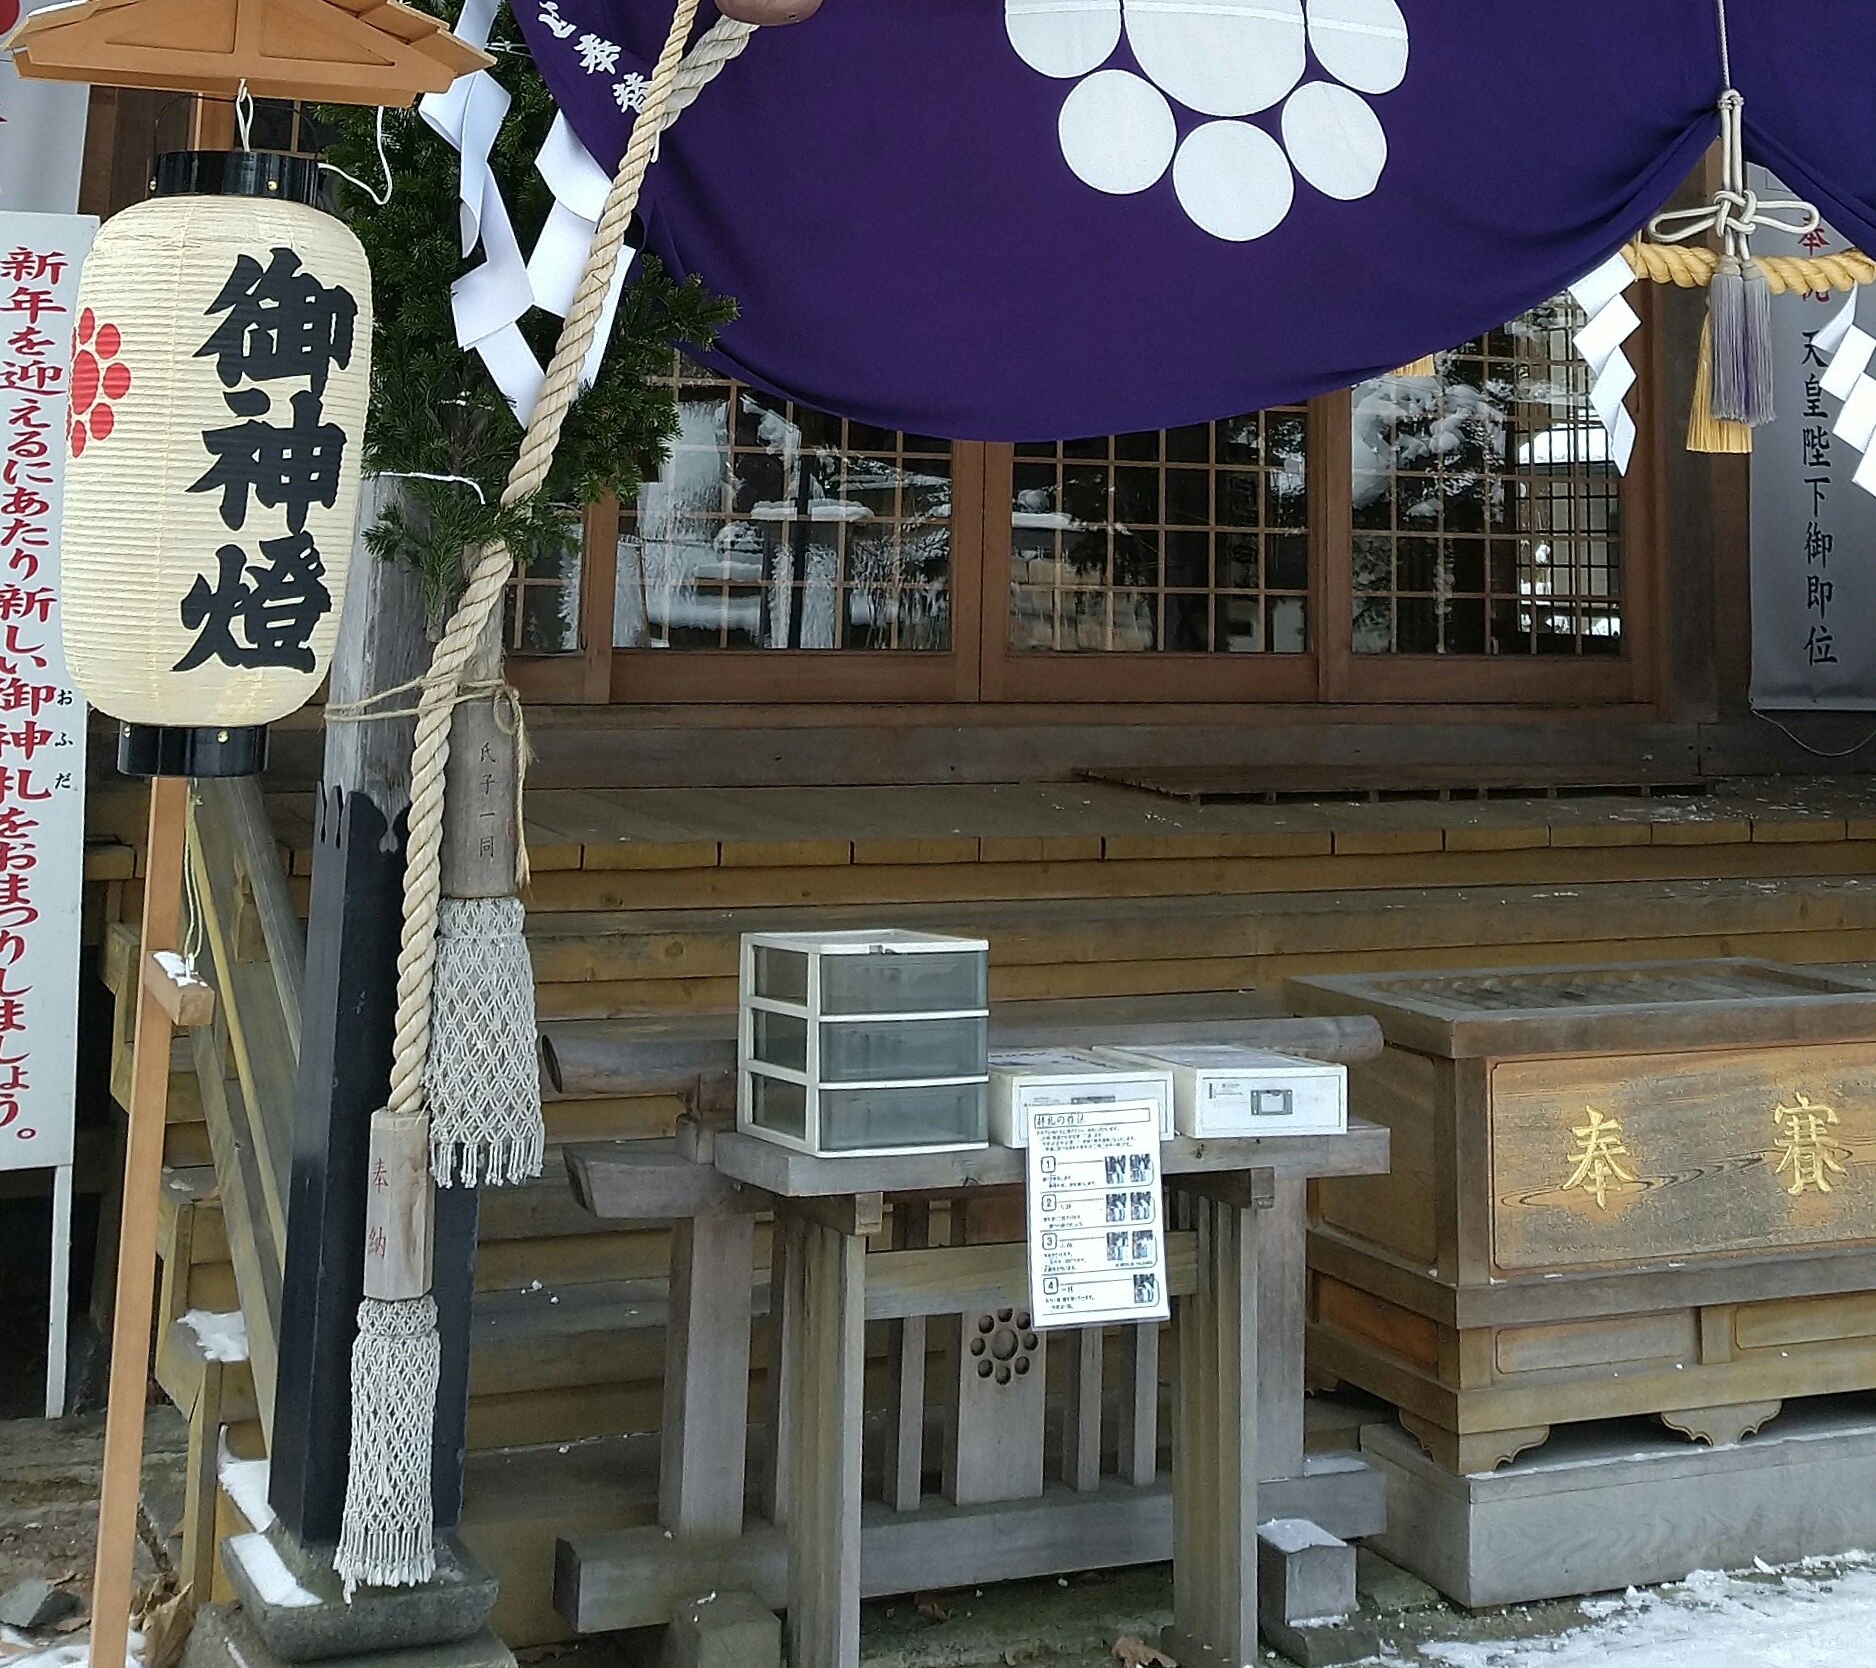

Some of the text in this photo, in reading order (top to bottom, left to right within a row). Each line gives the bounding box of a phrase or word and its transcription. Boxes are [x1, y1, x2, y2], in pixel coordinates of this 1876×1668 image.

[172, 246, 359, 674] 御神燈
[1801, 329, 1838, 668] 天皇陛下御即位
[54, 688, 74, 790] おふだ
[479, 741, 497, 858] 氏子一同
[367, 1157, 389, 1259] 奉納
